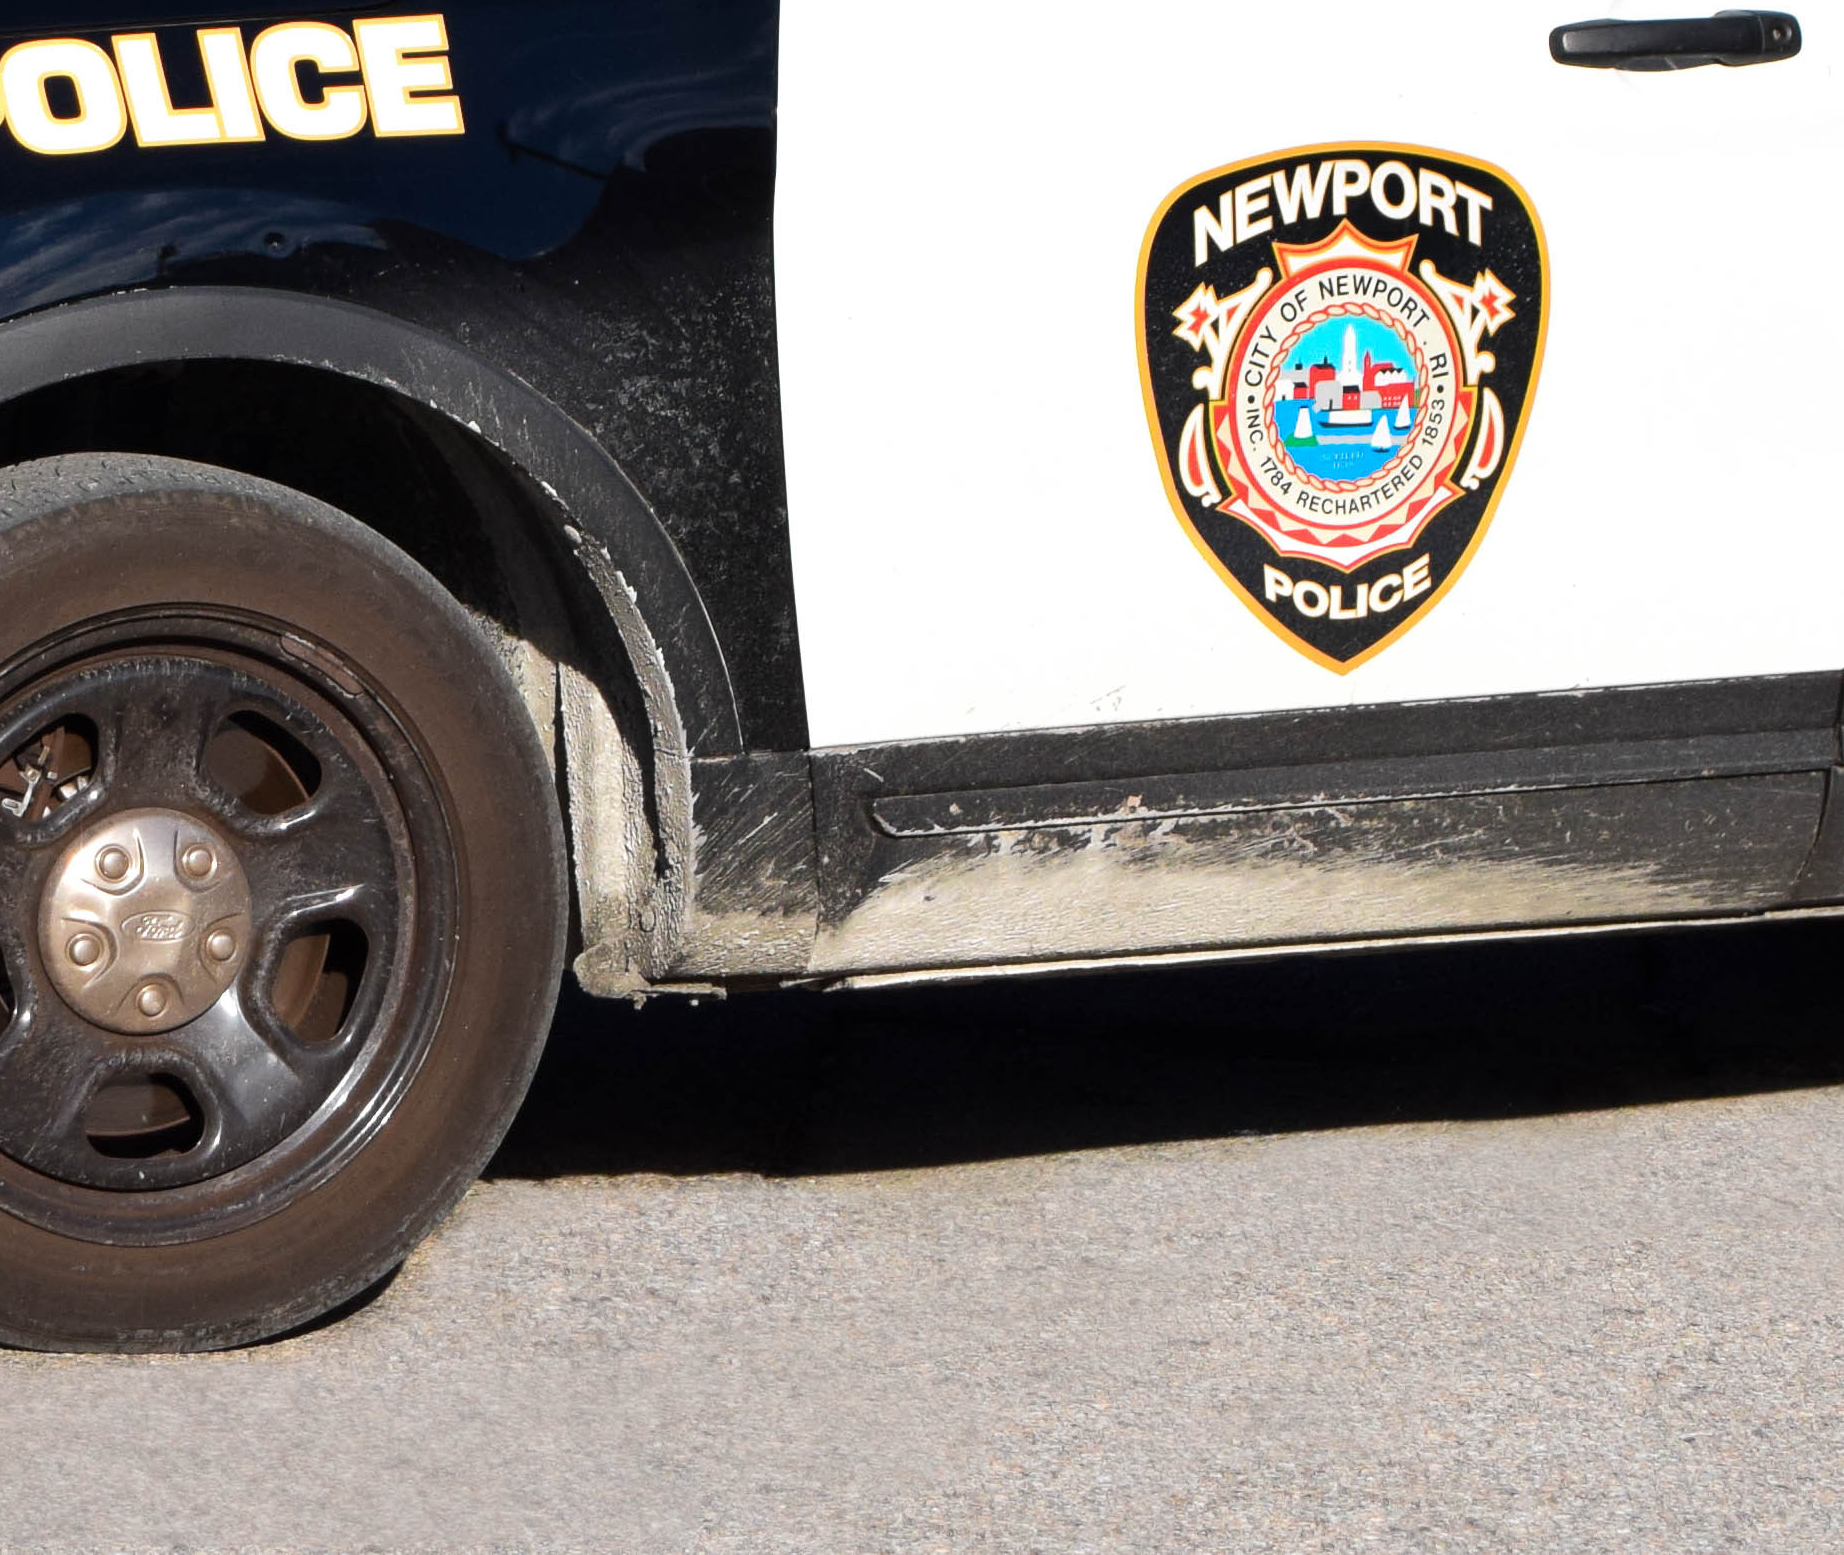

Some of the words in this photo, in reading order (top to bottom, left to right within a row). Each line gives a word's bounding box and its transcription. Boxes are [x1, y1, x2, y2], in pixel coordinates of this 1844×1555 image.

[1192, 158, 1494, 268] NEWPORT
[1245, 325, 1278, 387] CITY
[1280, 289, 1309, 323] OF
[1318, 274, 1430, 329] NEWPORT
[1429, 352, 1449, 379] RI
[1246, 408, 1264, 452] INC.
[1260, 455, 1293, 495] 1784
[1296, 454, 1423, 516] RECHARTERED
[1421, 398, 1446, 447] 1853
[1263, 553, 1432, 620] POLICE
